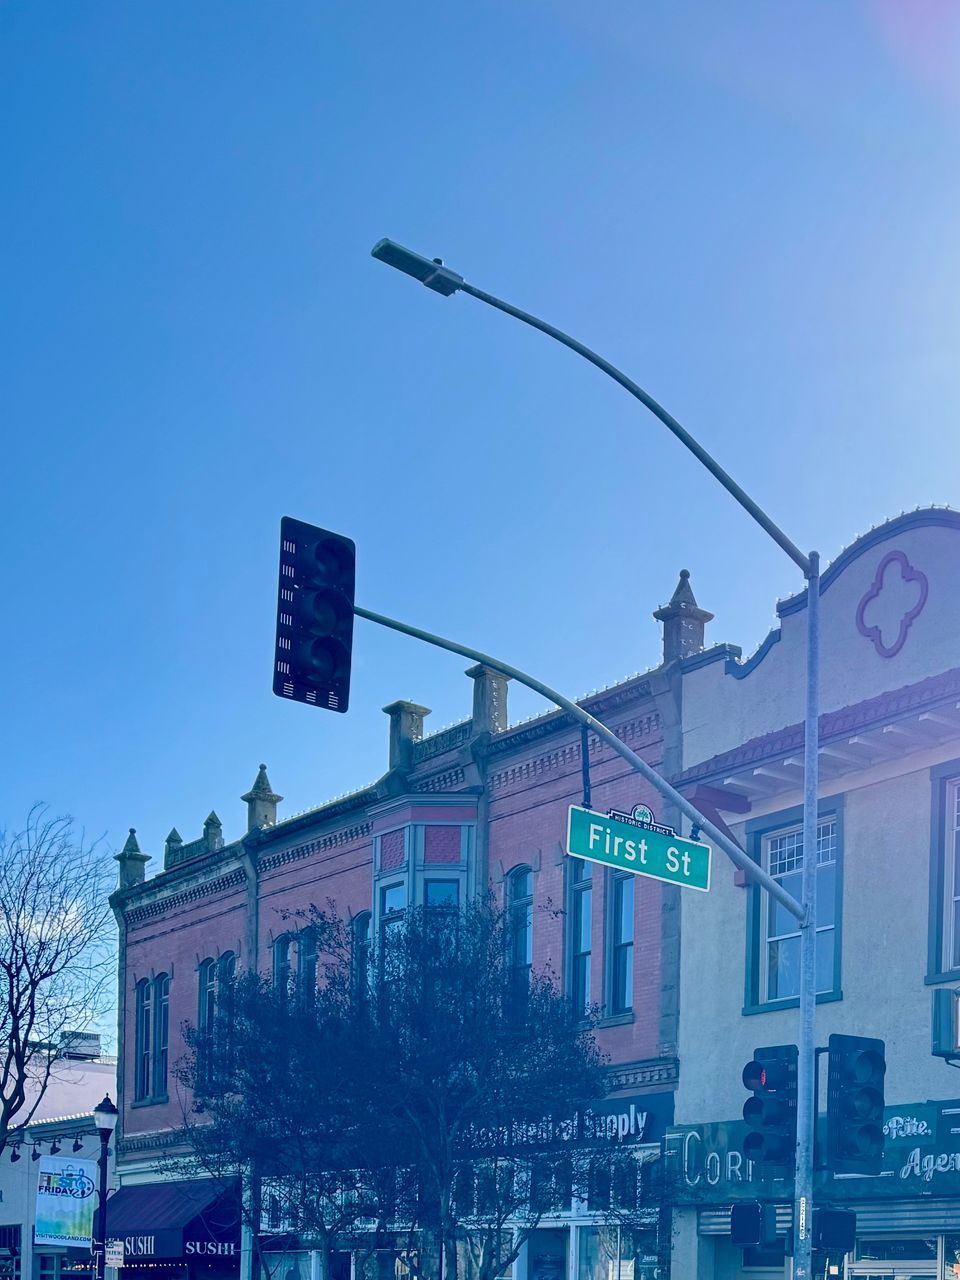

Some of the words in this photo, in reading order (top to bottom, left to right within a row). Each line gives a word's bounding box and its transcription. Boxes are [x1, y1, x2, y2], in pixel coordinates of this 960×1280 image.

[614, 815, 642, 828] HISTORIC
[643, 823, 670, 836] DISTRICT
[589, 823, 648, 864] First
[665, 846, 691, 876] St
[512, 1111, 578, 1146] Medial
[583, 1104, 648, 1143] Supply
[38, 1185, 74, 1195] FRIDAY
[35, 1233, 92, 1242] VISITWOODLAND.COM
[125, 1236, 154, 1256] SUSHI
[185, 1241, 235, 1256] SUSHI
